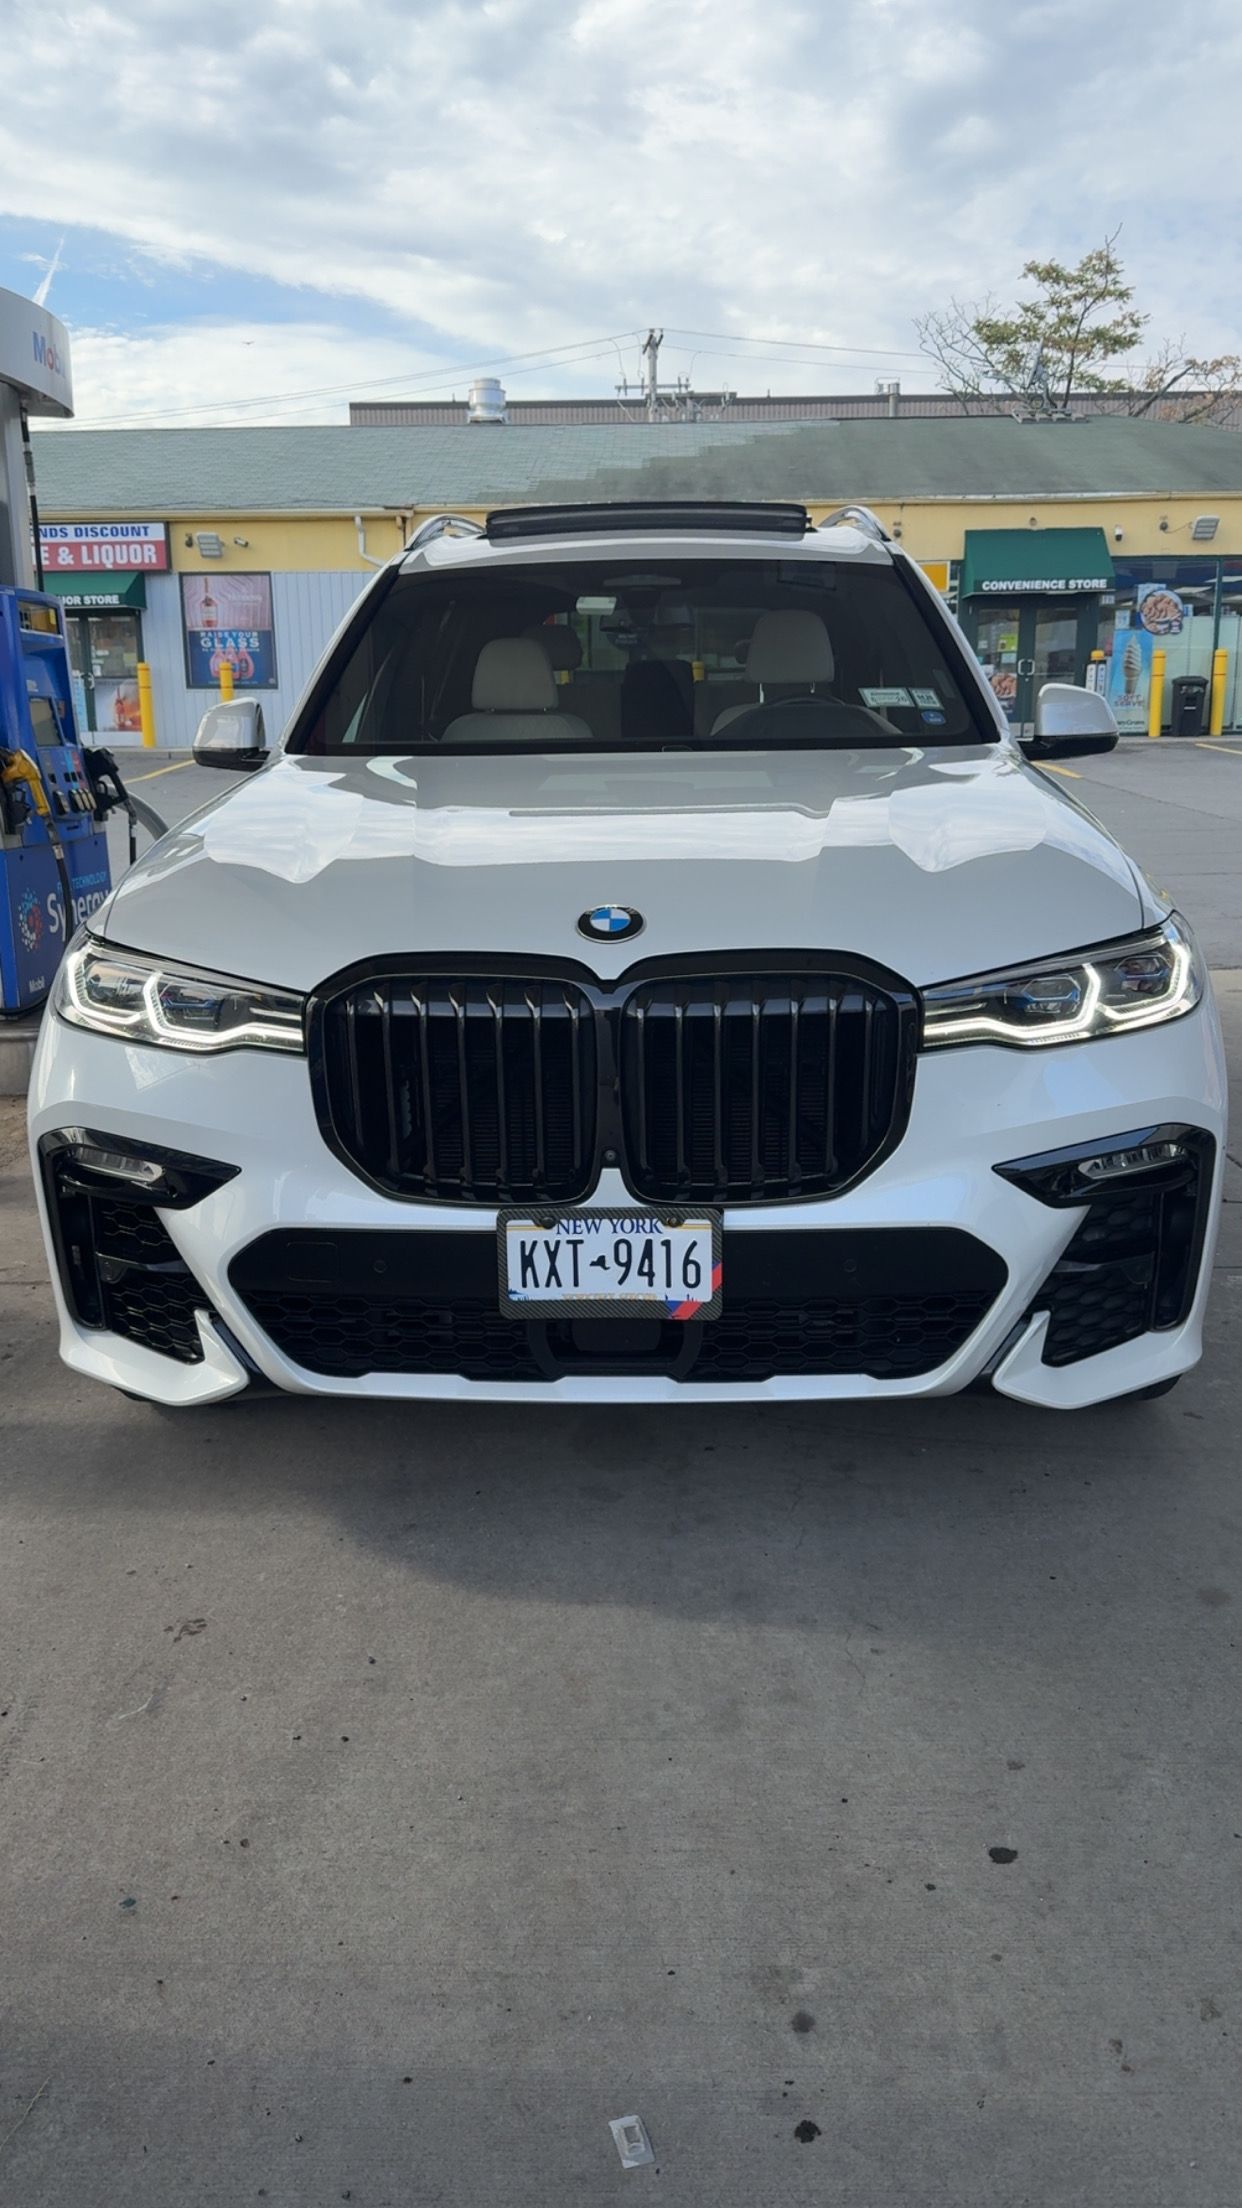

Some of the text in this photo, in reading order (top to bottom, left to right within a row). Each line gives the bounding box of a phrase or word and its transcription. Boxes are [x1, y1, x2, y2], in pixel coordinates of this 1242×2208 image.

[30, 526, 150, 539] NDS DISCOUNT
[57, 546, 75, 566] &
[81, 543, 157, 569] LIQUOR
[982, 579, 1107, 591] CONVENIENCE STORE
[83, 595, 120, 605] STORE
[200, 637, 260, 649] GLASS
[555, 1217, 663, 1235] NEW YORK
[519, 1238, 701, 1289] KXT 9416
